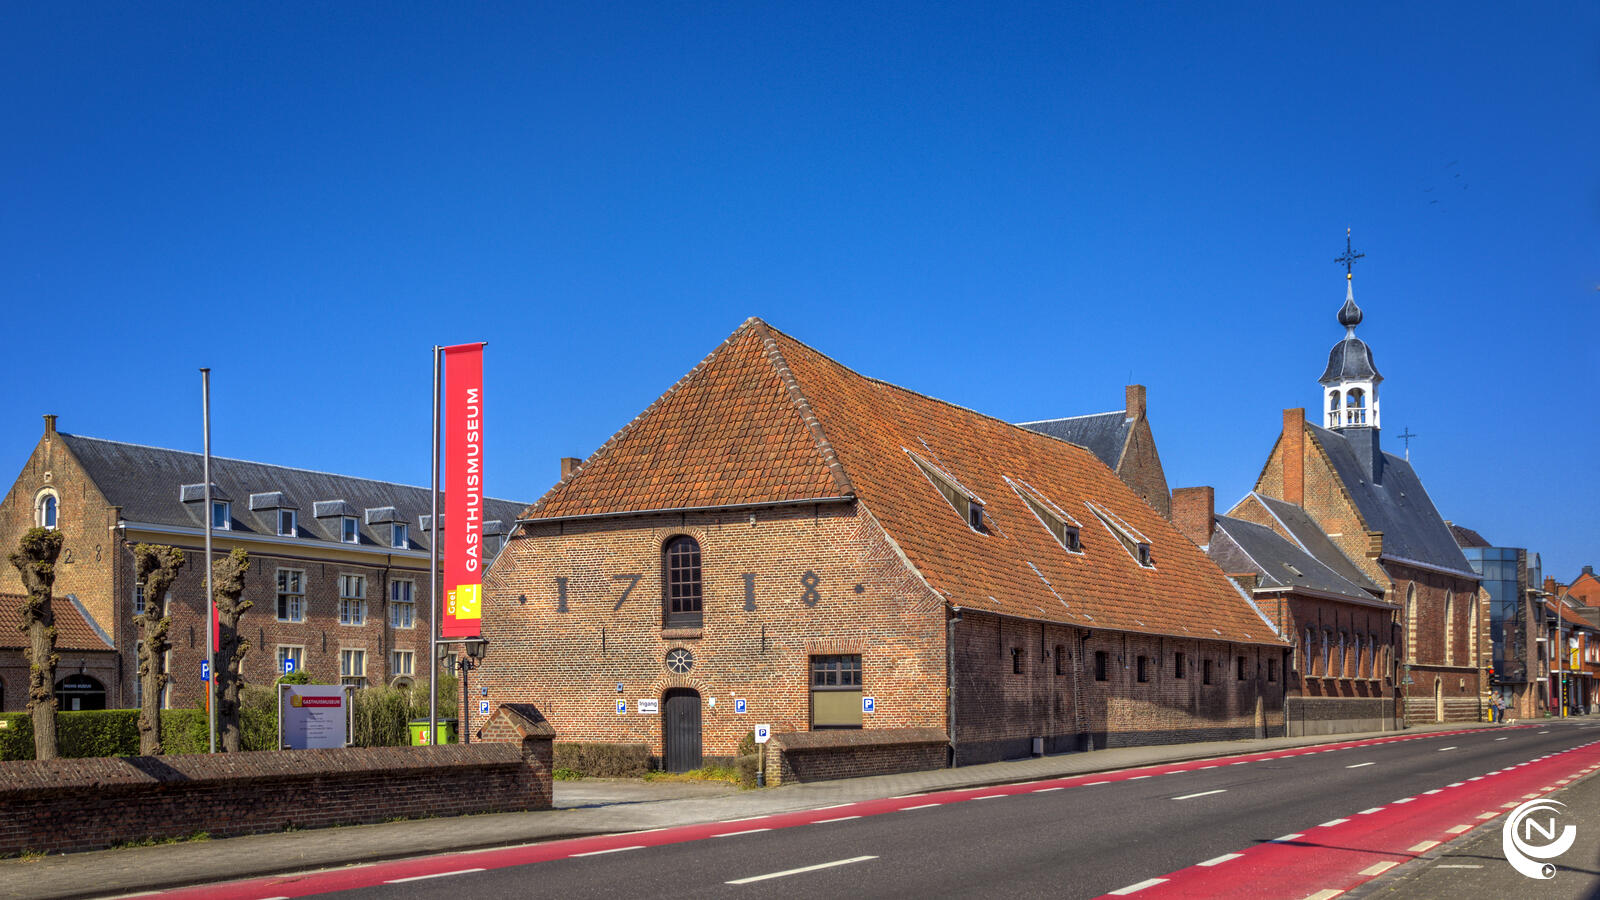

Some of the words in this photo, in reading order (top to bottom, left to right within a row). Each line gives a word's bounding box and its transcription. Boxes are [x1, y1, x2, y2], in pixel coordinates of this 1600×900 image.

[466, 388, 479, 572] GASTHUISMUSEUM
[448, 591, 456, 614] Geel
[202, 663, 209, 678] P
[285, 662, 293, 673] P
[481, 702, 488, 711] P
[737, 700, 744, 710] P
[865, 699, 873, 709] P
